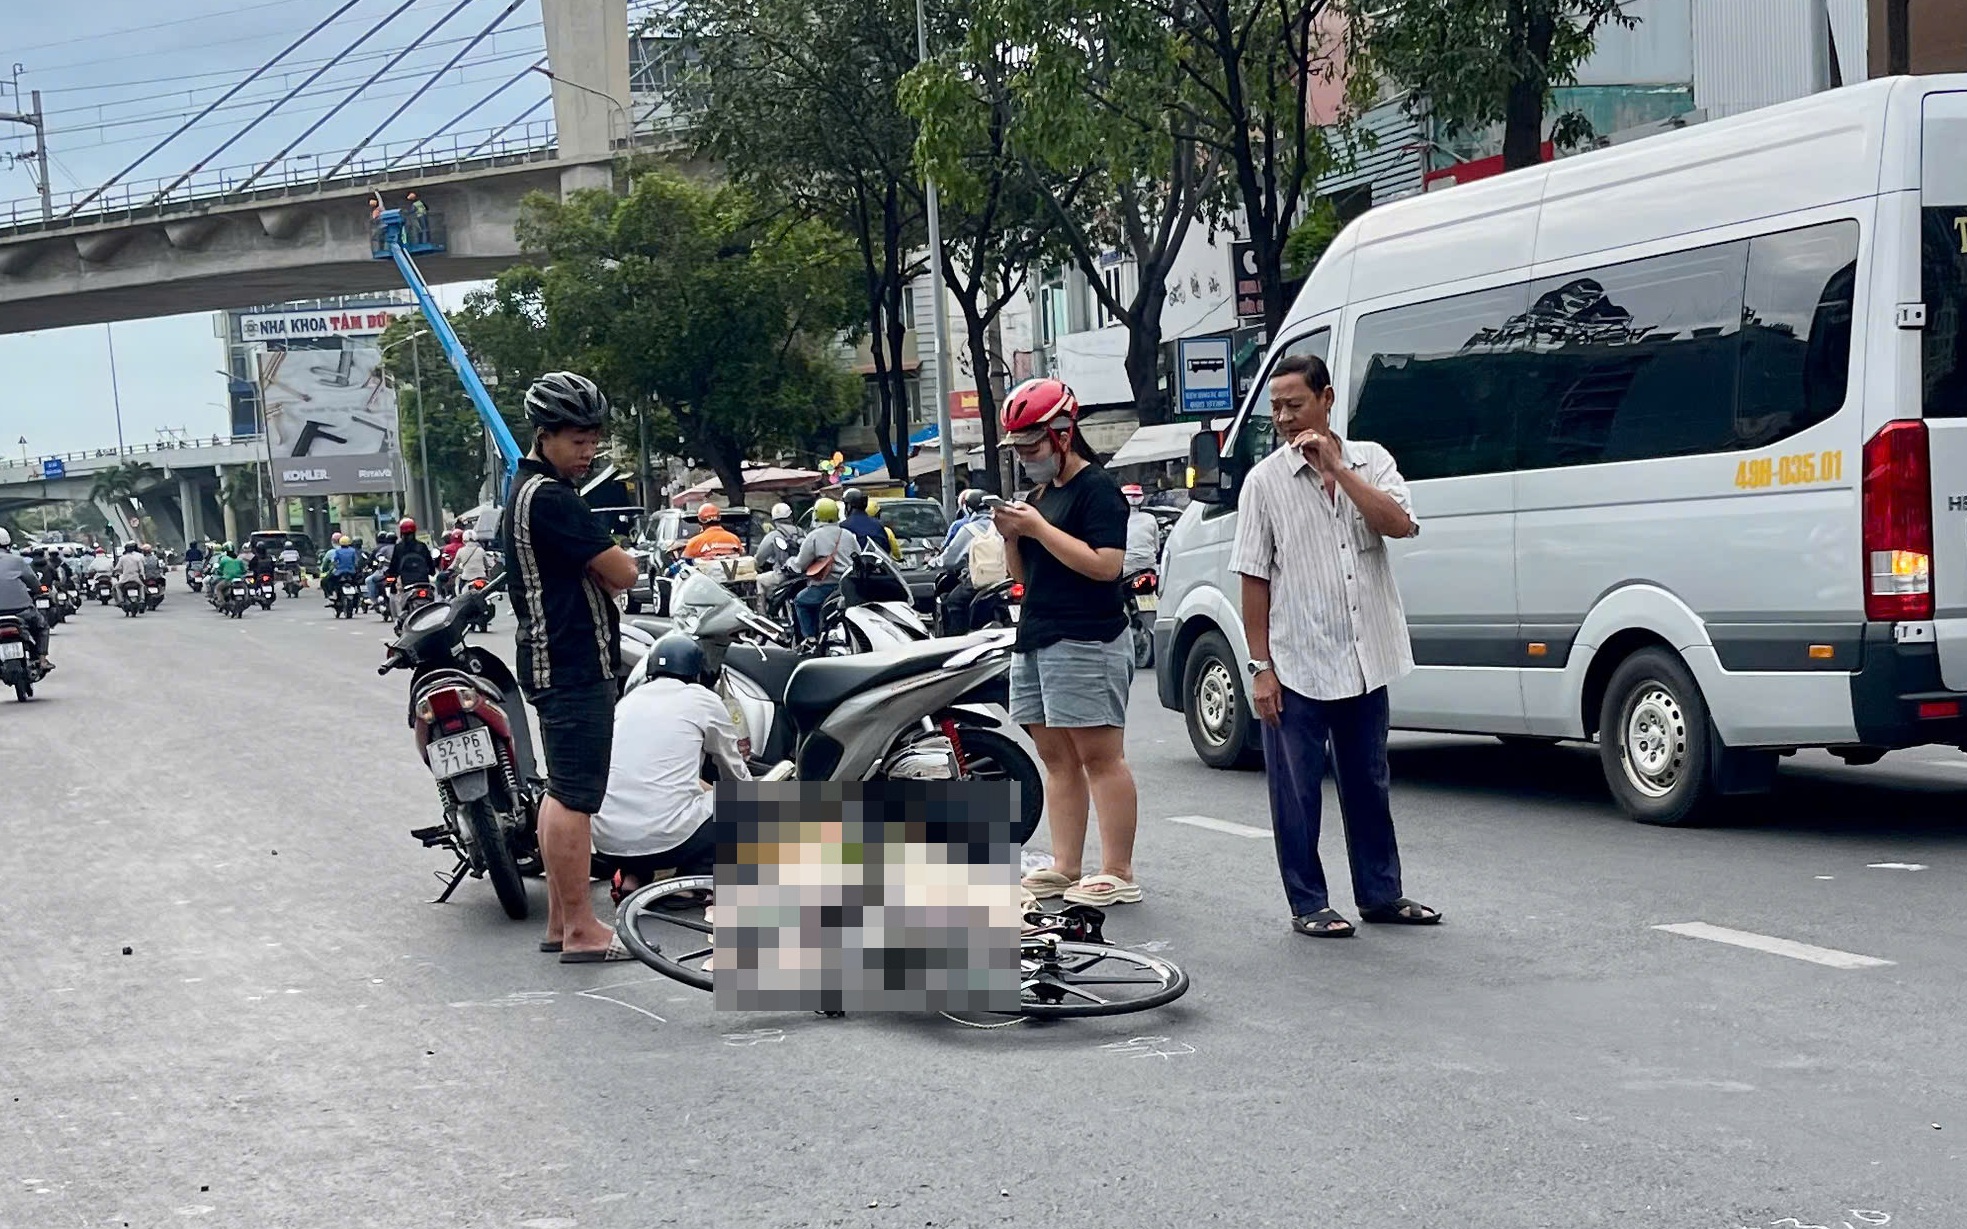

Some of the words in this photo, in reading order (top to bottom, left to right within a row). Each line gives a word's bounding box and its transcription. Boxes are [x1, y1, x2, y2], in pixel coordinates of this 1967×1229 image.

[260, 319, 287, 335] NHA
[291, 317, 327, 333] KHOA
[329, 312, 362, 331] TÂM
[442, 749, 485, 774] 7145
